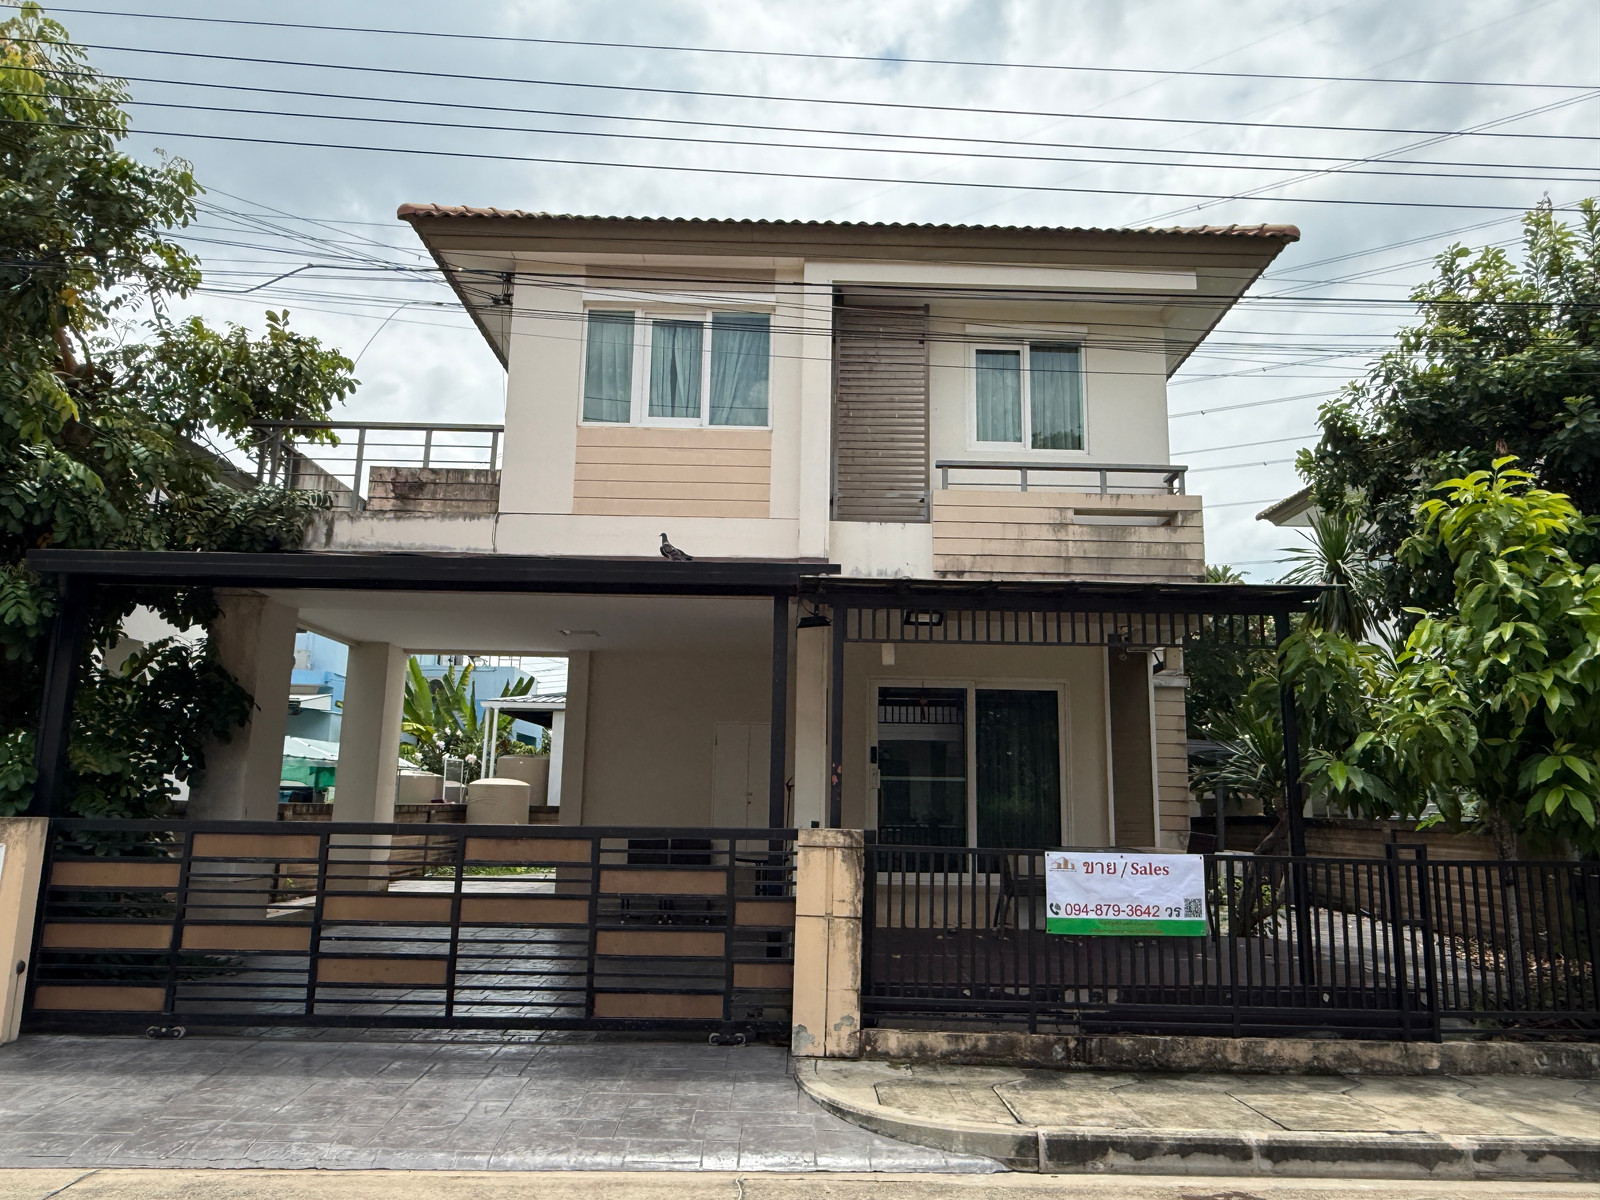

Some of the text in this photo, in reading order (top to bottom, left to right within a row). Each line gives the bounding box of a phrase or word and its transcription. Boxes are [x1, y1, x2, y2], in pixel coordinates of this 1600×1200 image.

[1082, 861, 1117, 875] ขาย
[1130, 862, 1170, 876] Sales
[1064, 902, 1161, 918] 094-879-3642
